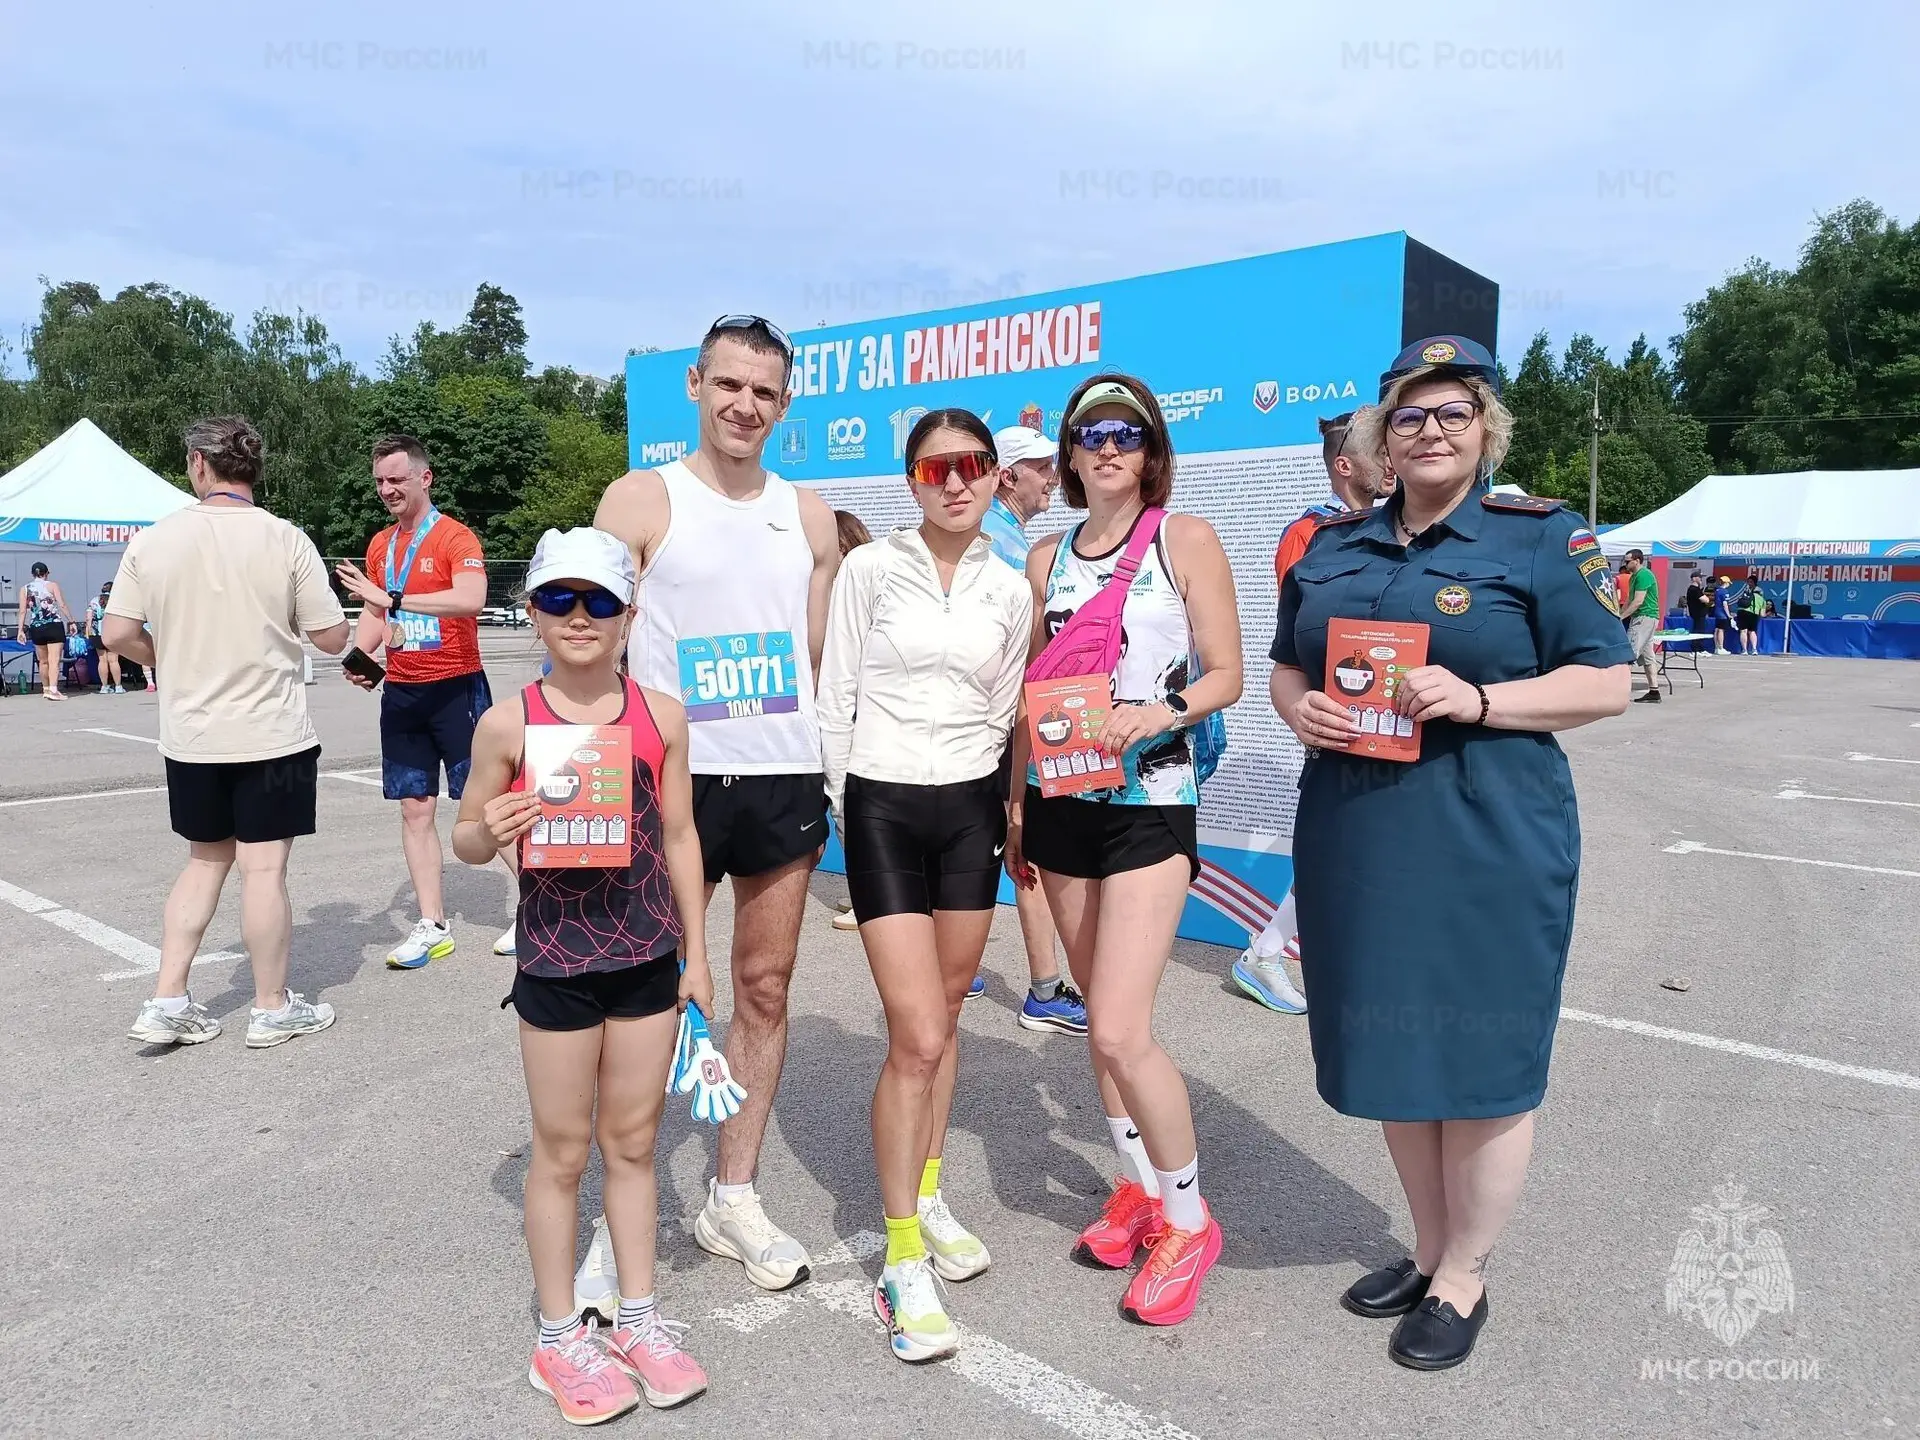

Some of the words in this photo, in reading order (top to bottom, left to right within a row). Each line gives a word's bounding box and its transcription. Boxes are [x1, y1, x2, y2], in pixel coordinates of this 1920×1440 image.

[859, 334, 895, 392] ЗА
[902, 301, 1101, 386] РАМЕНСКОЕ
[1155, 387, 1223, 408] ОСОБЛ
[1286, 381, 1358, 404] ВФЛА
[1164, 406, 1204, 423] ОРТ
[828, 445, 866, 454] РАМЕНСКОЕ
[39, 521, 143, 543] ХРОНОМЕТРА
[1719, 541, 1789, 555] ИНФОРМАЦИЯ
[1797, 541, 1870, 555] РЕГИСТРАЦИЯ
[1748, 565, 1829, 582] СТАРТОВЫЕ
[1832, 565, 1893, 582] ПАКЕТЫ
[694, 655, 785, 701] 50171
[726, 698, 764, 718] 10KM
